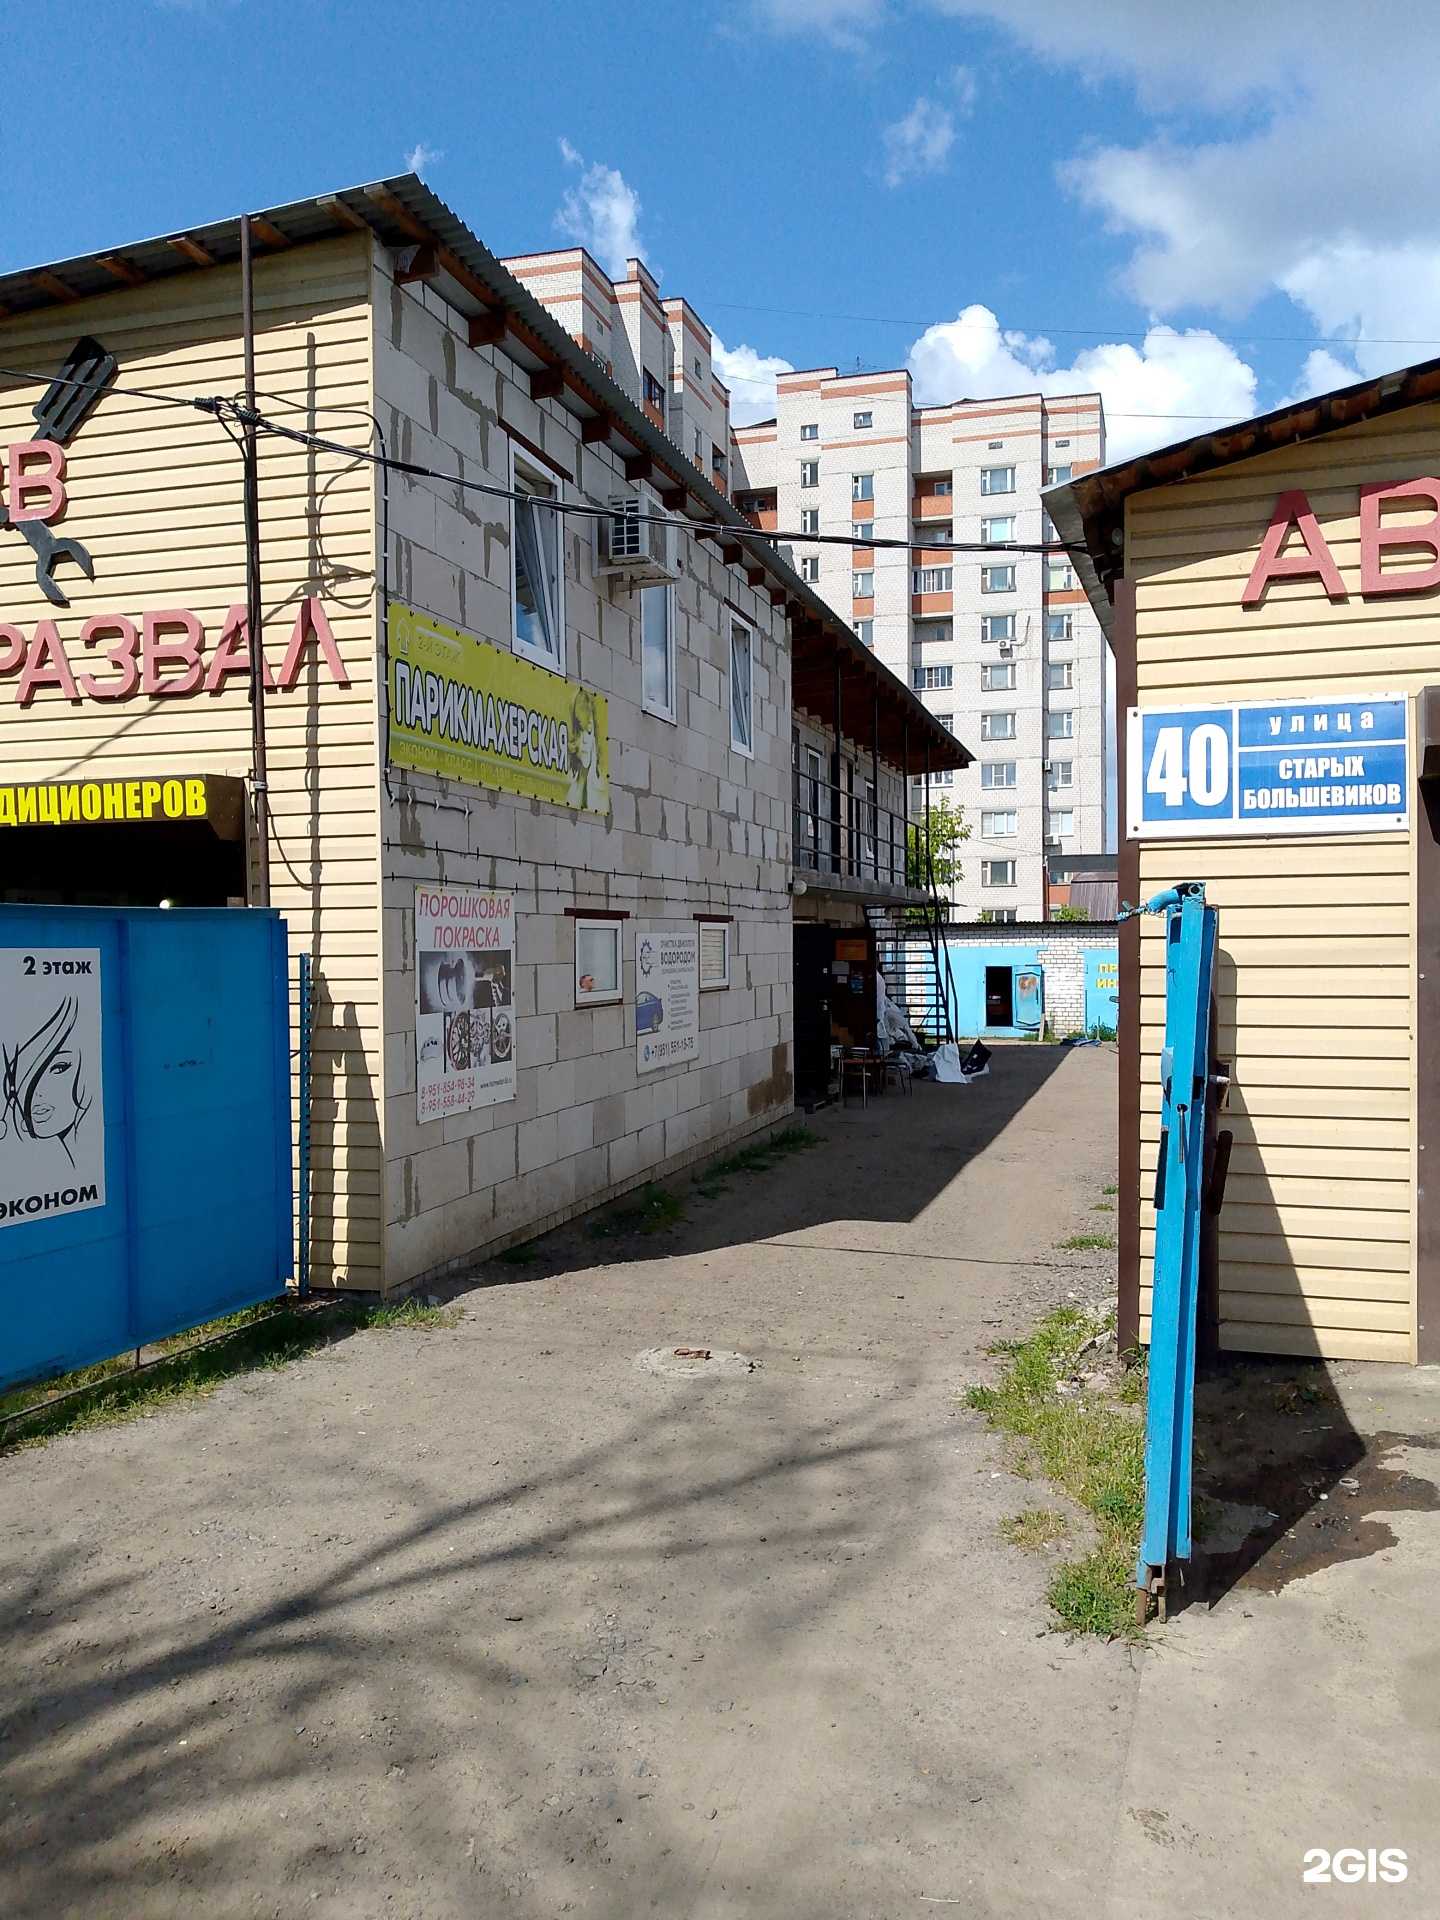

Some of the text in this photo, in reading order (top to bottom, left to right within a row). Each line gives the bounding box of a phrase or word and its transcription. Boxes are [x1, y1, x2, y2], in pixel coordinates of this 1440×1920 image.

[0, 439, 66, 523] В
[1241, 477, 1440, 606] АВ
[394, 658, 569, 774] ПАРИКМАХЕРСКАЯ
[1269, 711, 1374, 736] улица
[1146, 723, 1229, 807] 40
[1278, 755, 1365, 780] СТАРЫХ
[0, 780, 207, 826] ДИЦИОНЕРОВ
[1243, 783, 1401, 810] БОЛЬШЕВИКОВ
[419, 893, 511, 919] ПОРОШКОВАЯ
[433, 926, 500, 948] ПОКРАСКА
[23, 956, 92, 975] 2 этаж
